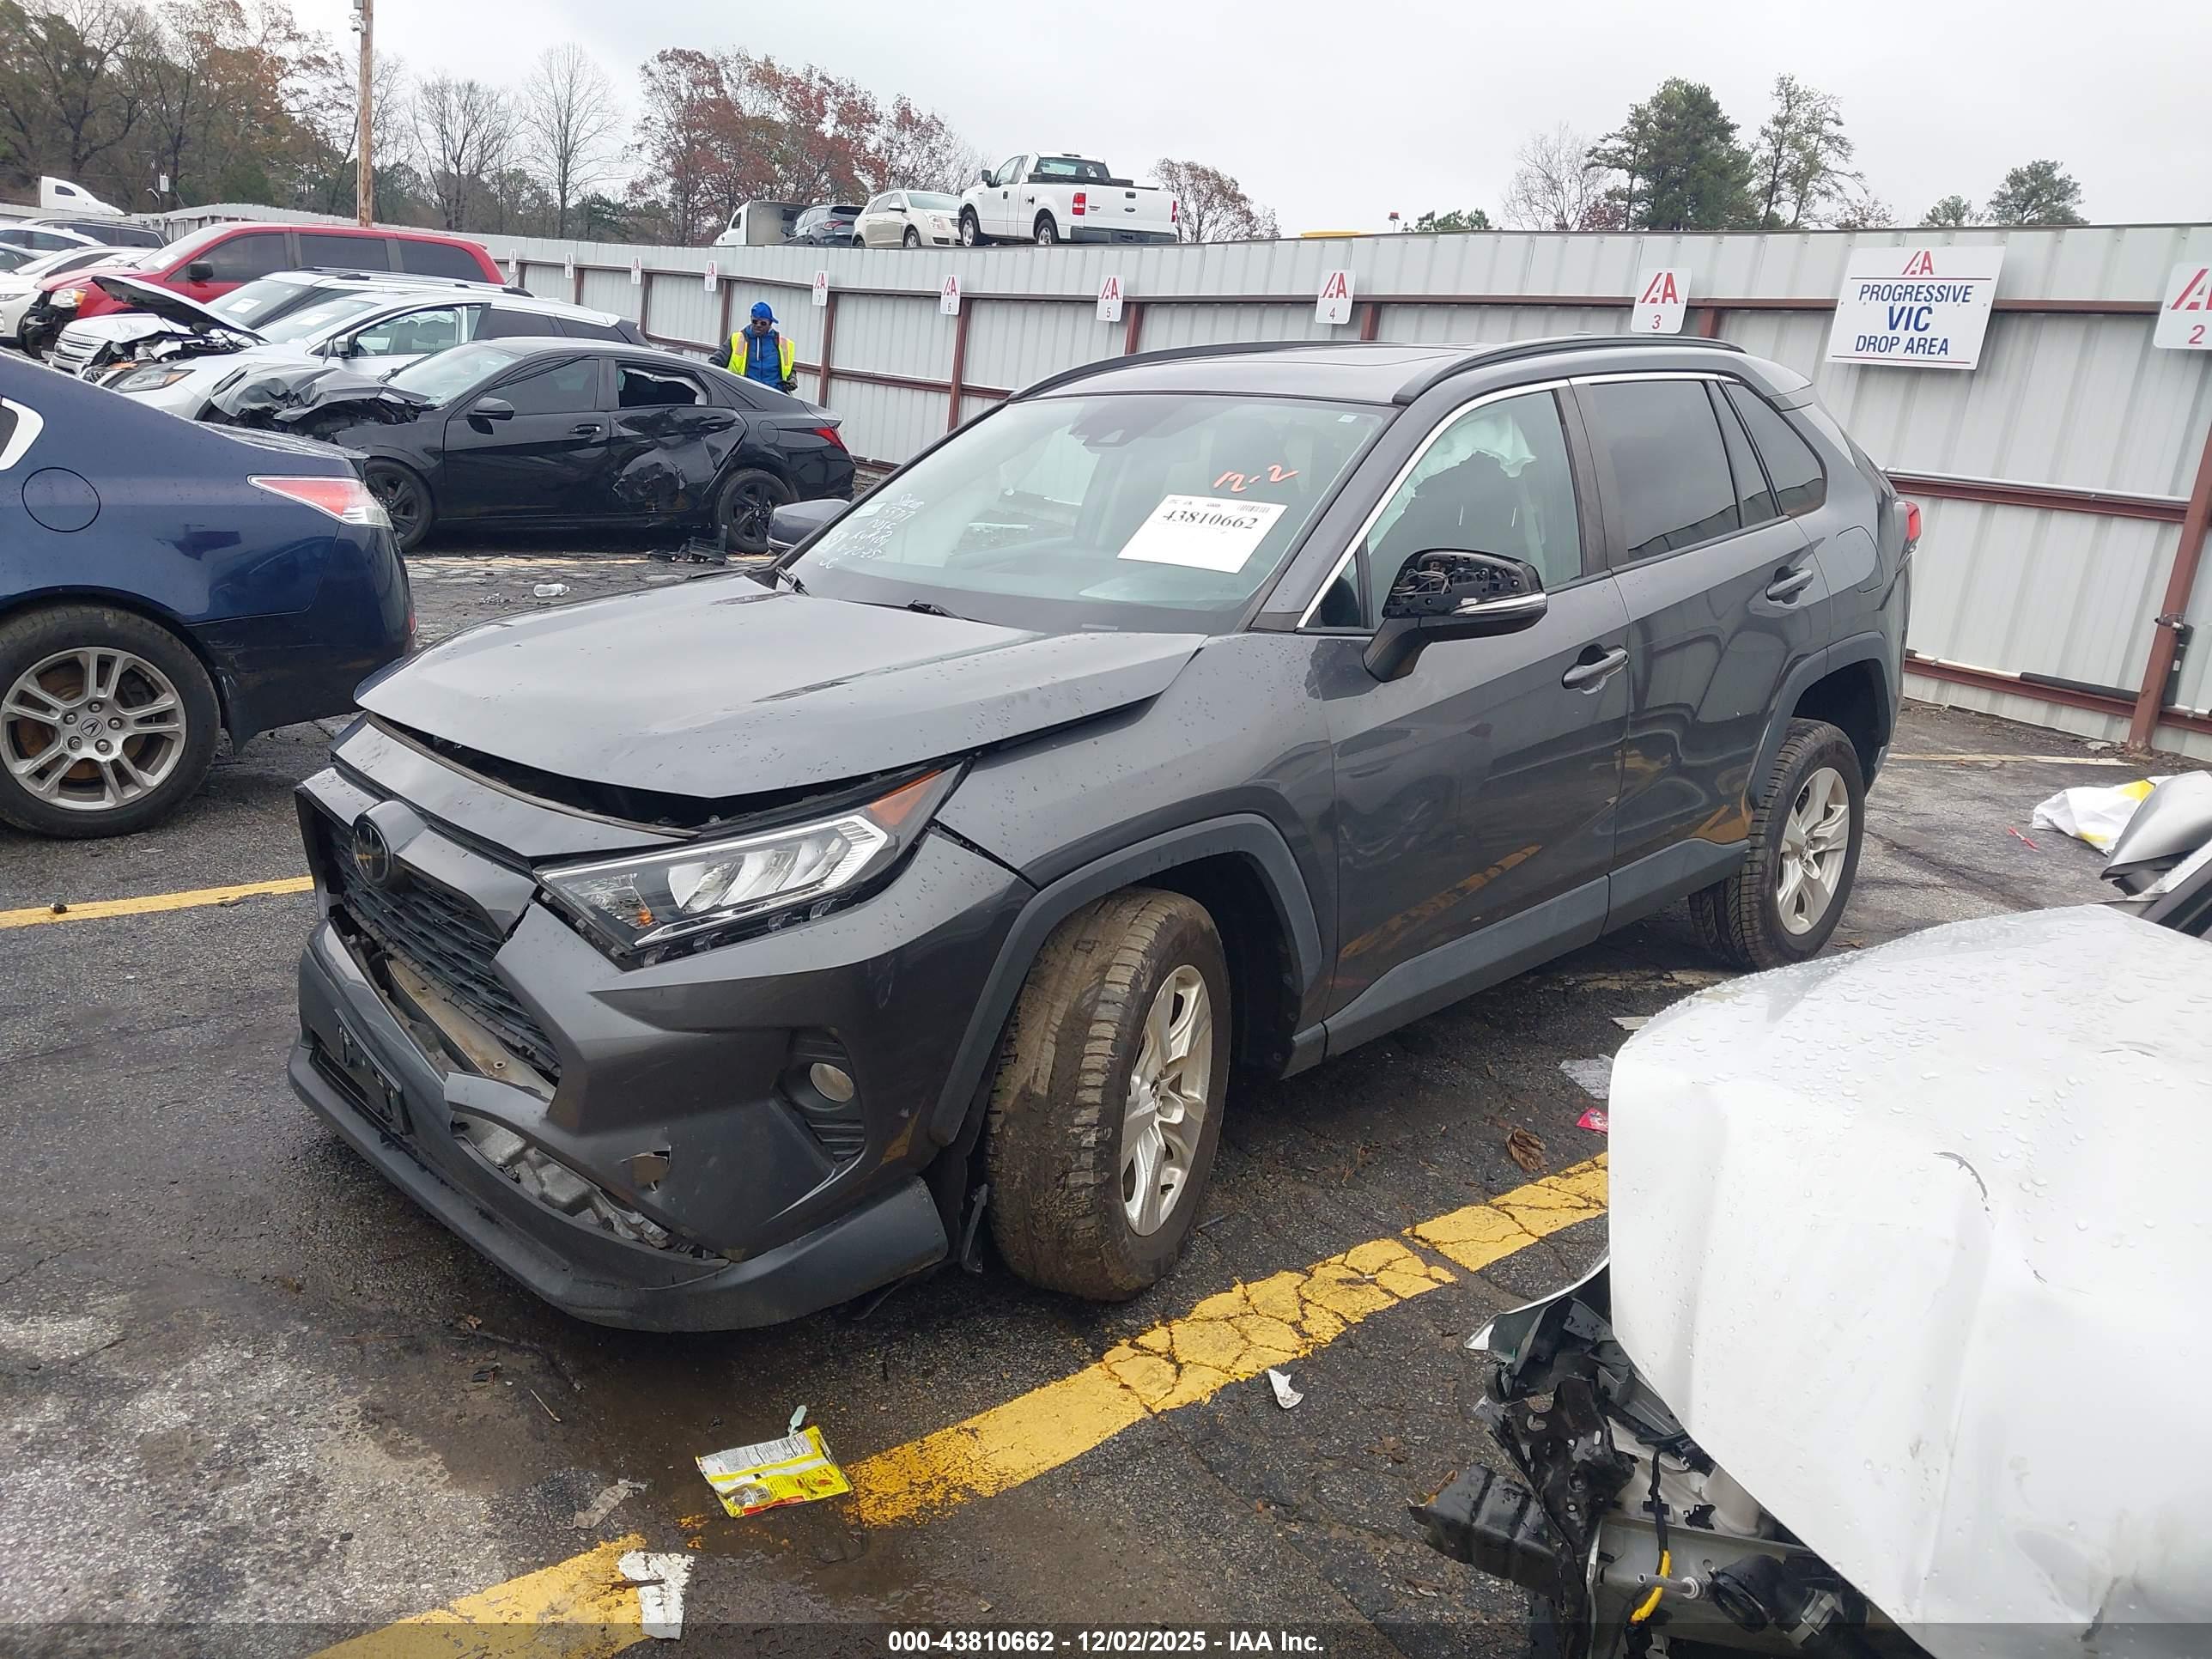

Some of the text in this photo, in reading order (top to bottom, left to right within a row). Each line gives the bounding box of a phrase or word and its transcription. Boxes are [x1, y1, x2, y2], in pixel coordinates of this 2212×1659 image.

[1858, 283, 1974, 303] PROGRESSIVE
[947, 301, 952, 312] 6
[1106, 307, 1112, 318] 5
[1328, 307, 1336, 320] 4
[1651, 314, 1662, 330] 3
[1888, 305, 1933, 332] VIC
[2188, 324, 2206, 344] 2
[1855, 335, 1949, 356] DROP AREA
[1163, 509, 1259, 530] 43810662
